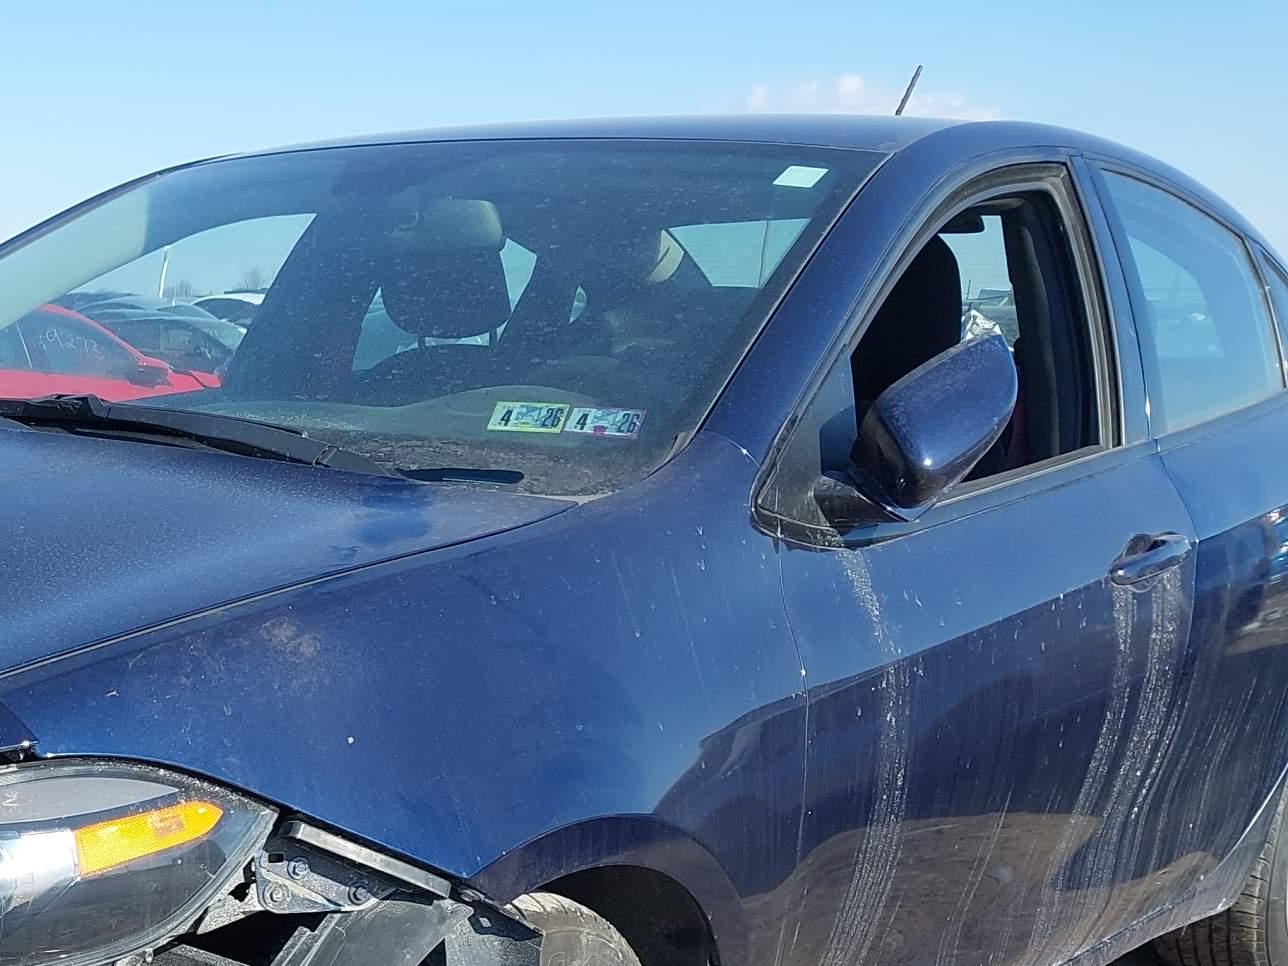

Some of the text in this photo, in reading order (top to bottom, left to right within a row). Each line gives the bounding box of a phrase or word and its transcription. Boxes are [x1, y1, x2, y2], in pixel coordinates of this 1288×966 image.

[498, 407, 565, 428] 4 26
[574, 413, 641, 434] 4 26
